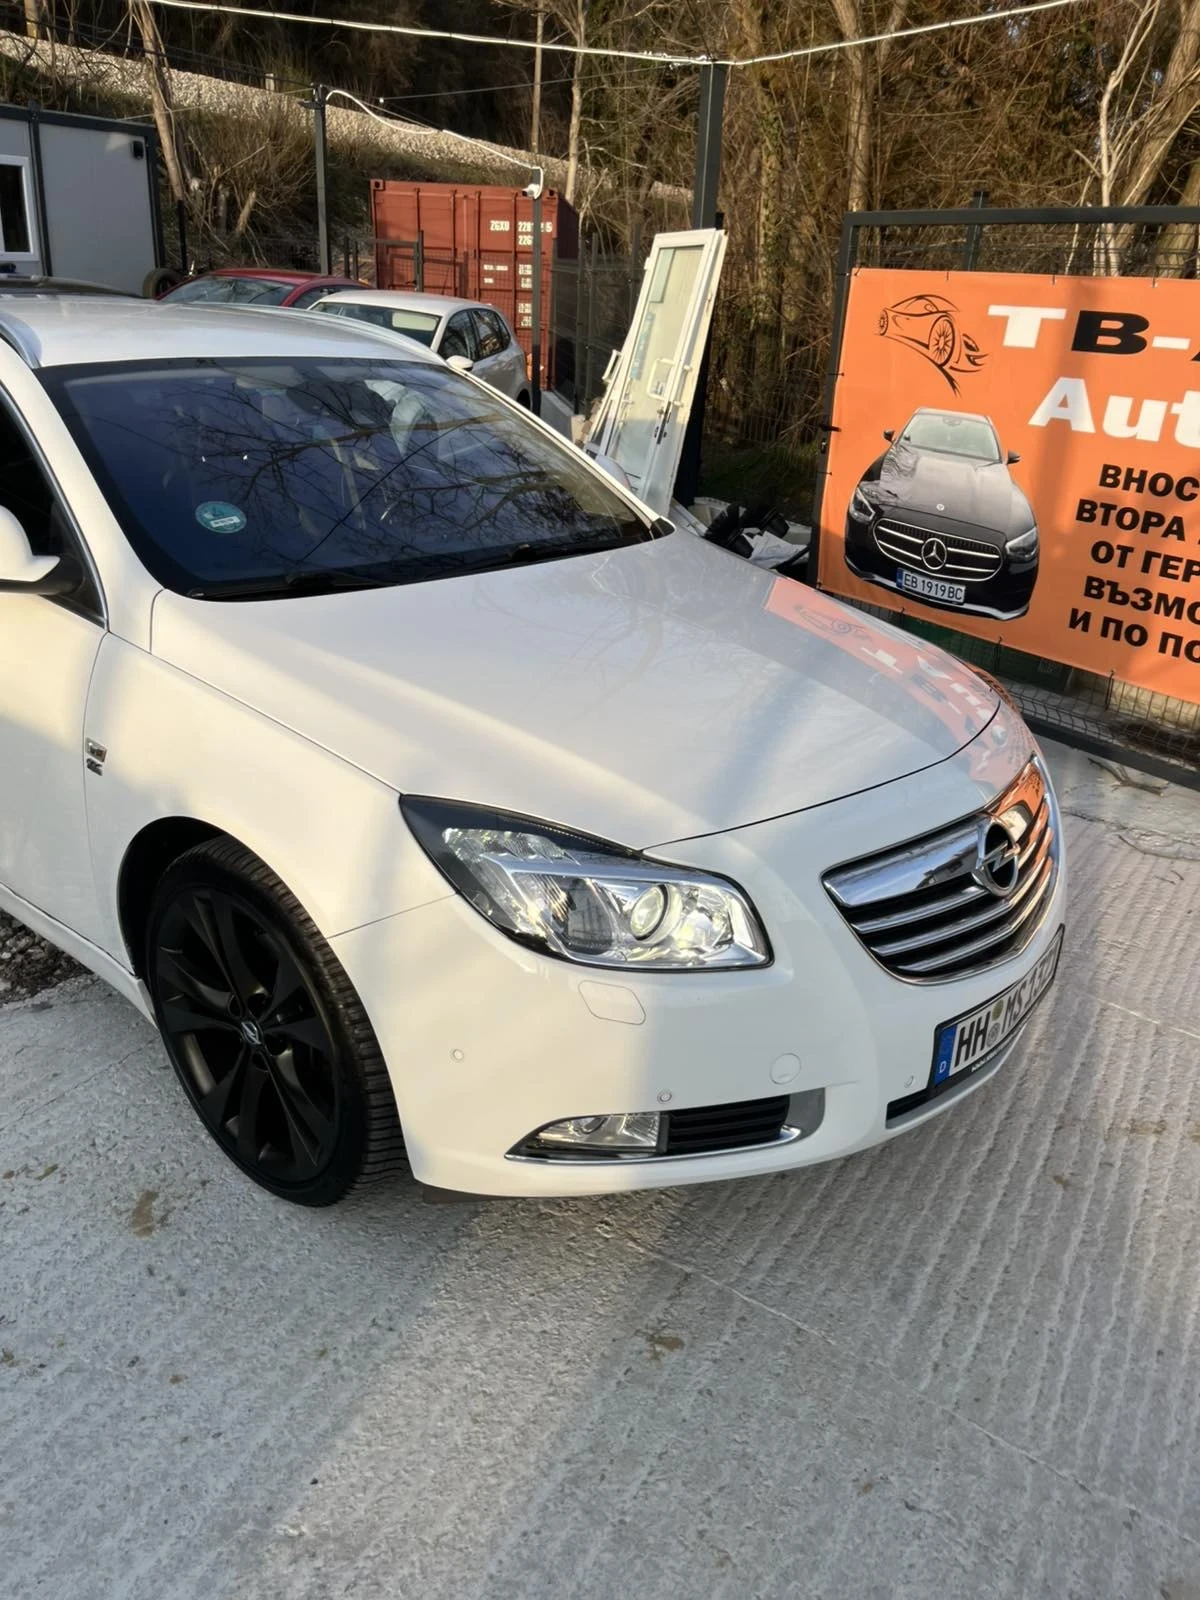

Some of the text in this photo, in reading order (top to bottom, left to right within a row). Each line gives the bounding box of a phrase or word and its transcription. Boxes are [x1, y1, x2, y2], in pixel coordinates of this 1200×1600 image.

[1099, 463, 1200, 502] ВНОС
[1075, 498, 1186, 542] ВТОРА
[1090, 540, 1135, 569] ОТ
[1068, 607, 1092, 633] И
[1099, 616, 1149, 648] ПО
[954, 1011, 991, 1068] HH
[938, 1060, 947, 1074] D
